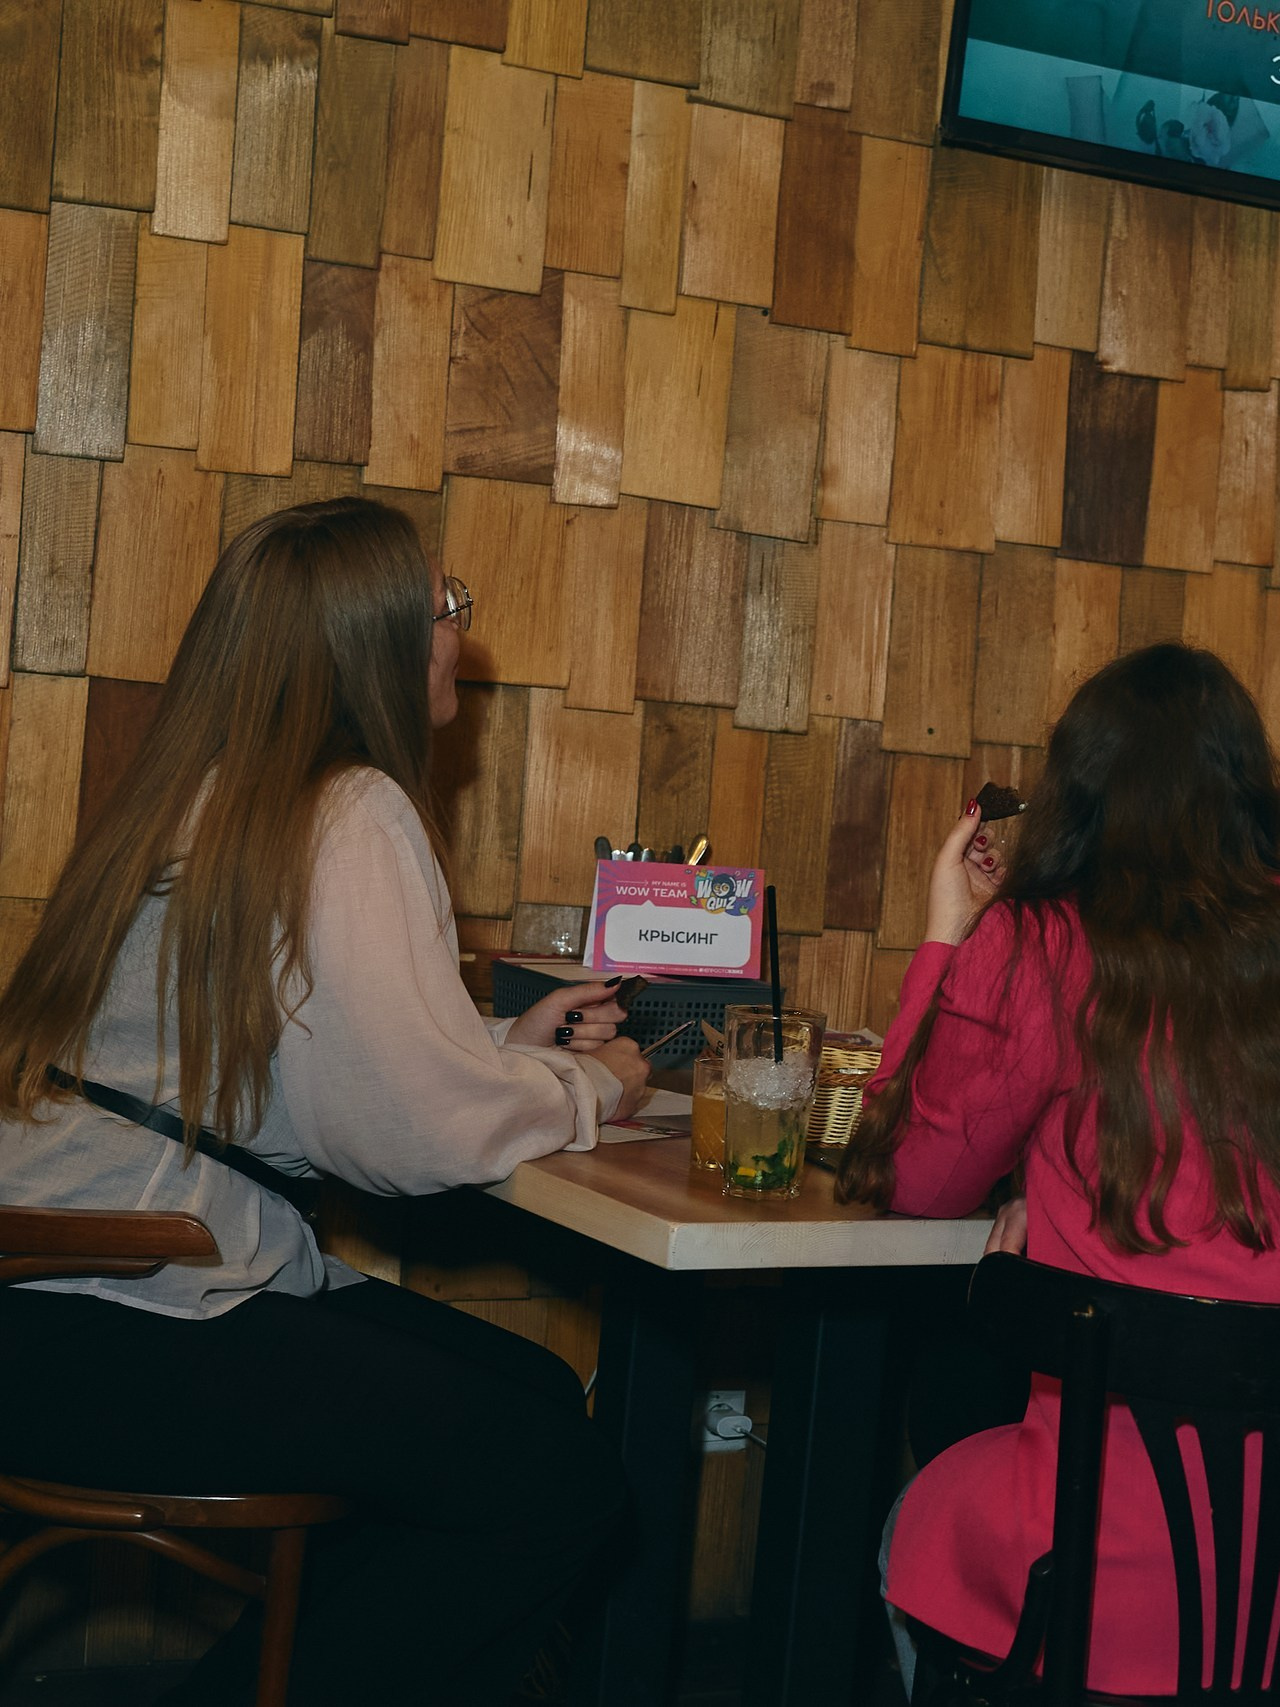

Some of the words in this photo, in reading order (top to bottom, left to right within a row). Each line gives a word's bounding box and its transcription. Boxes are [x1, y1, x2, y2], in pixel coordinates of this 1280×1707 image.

[616, 886, 650, 896] WOW
[653, 888, 687, 898] TEAM
[697, 874, 753, 899] WOW
[706, 896, 737, 910] QUIZ
[638, 929, 718, 945] КРЫСИНГ
